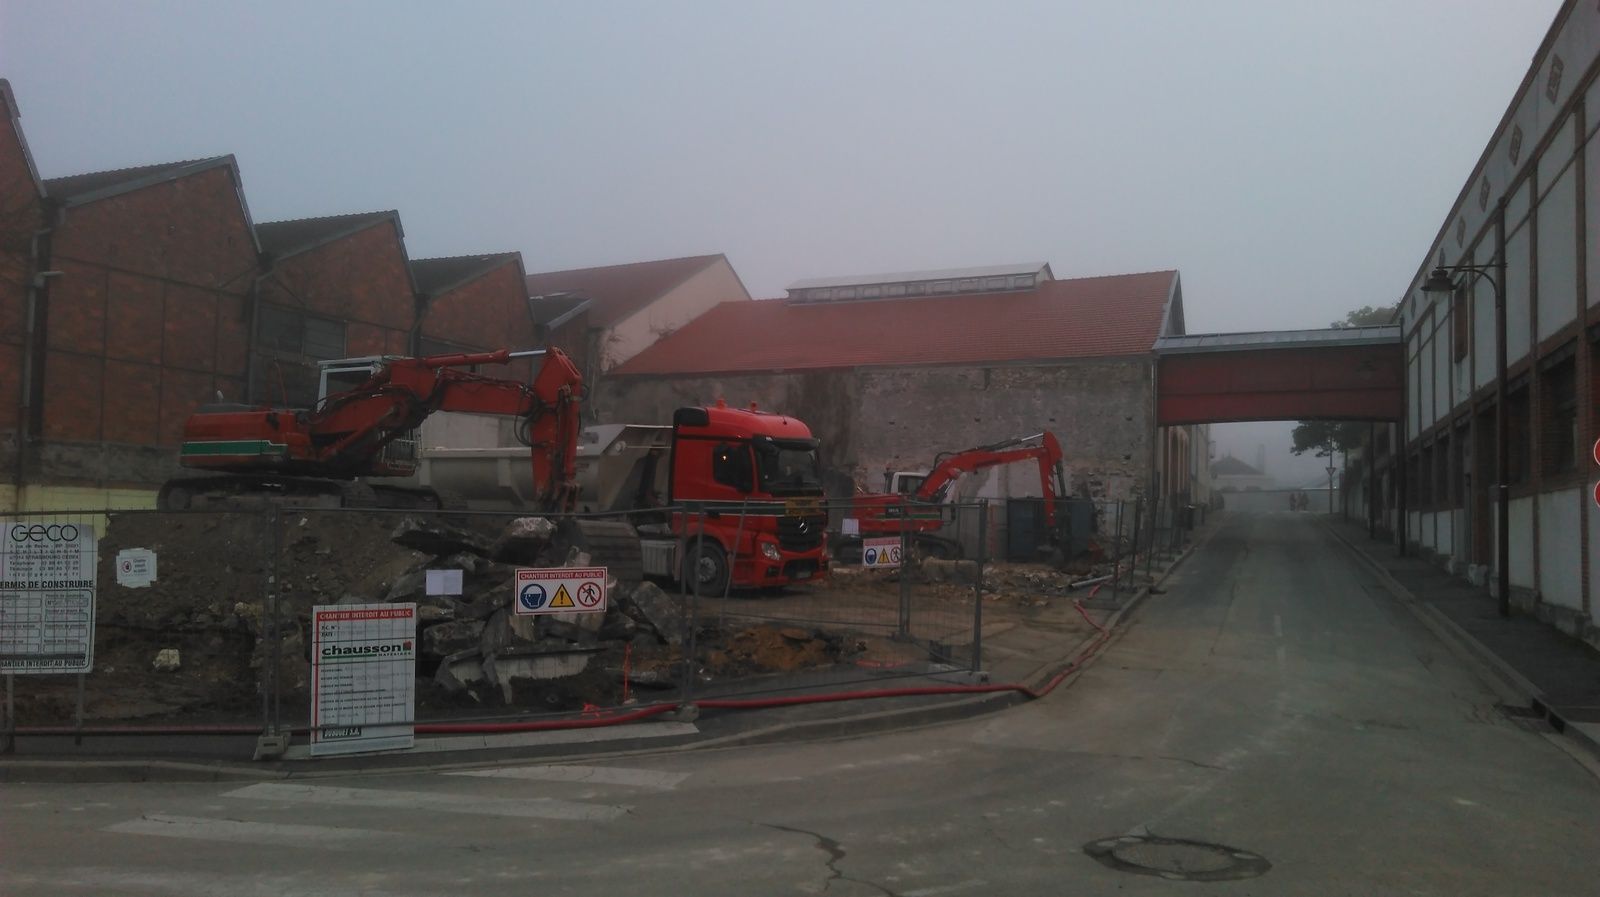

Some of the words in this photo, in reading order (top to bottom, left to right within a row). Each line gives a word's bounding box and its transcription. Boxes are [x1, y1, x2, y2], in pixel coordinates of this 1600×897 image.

[28, 581, 40, 589] DE
[42, 580, 93, 588] CONSTRUIRE
[320, 612, 350, 620] CHANTIER
[351, 611, 378, 619] INTERDIT
[321, 644, 401, 656] chausson
